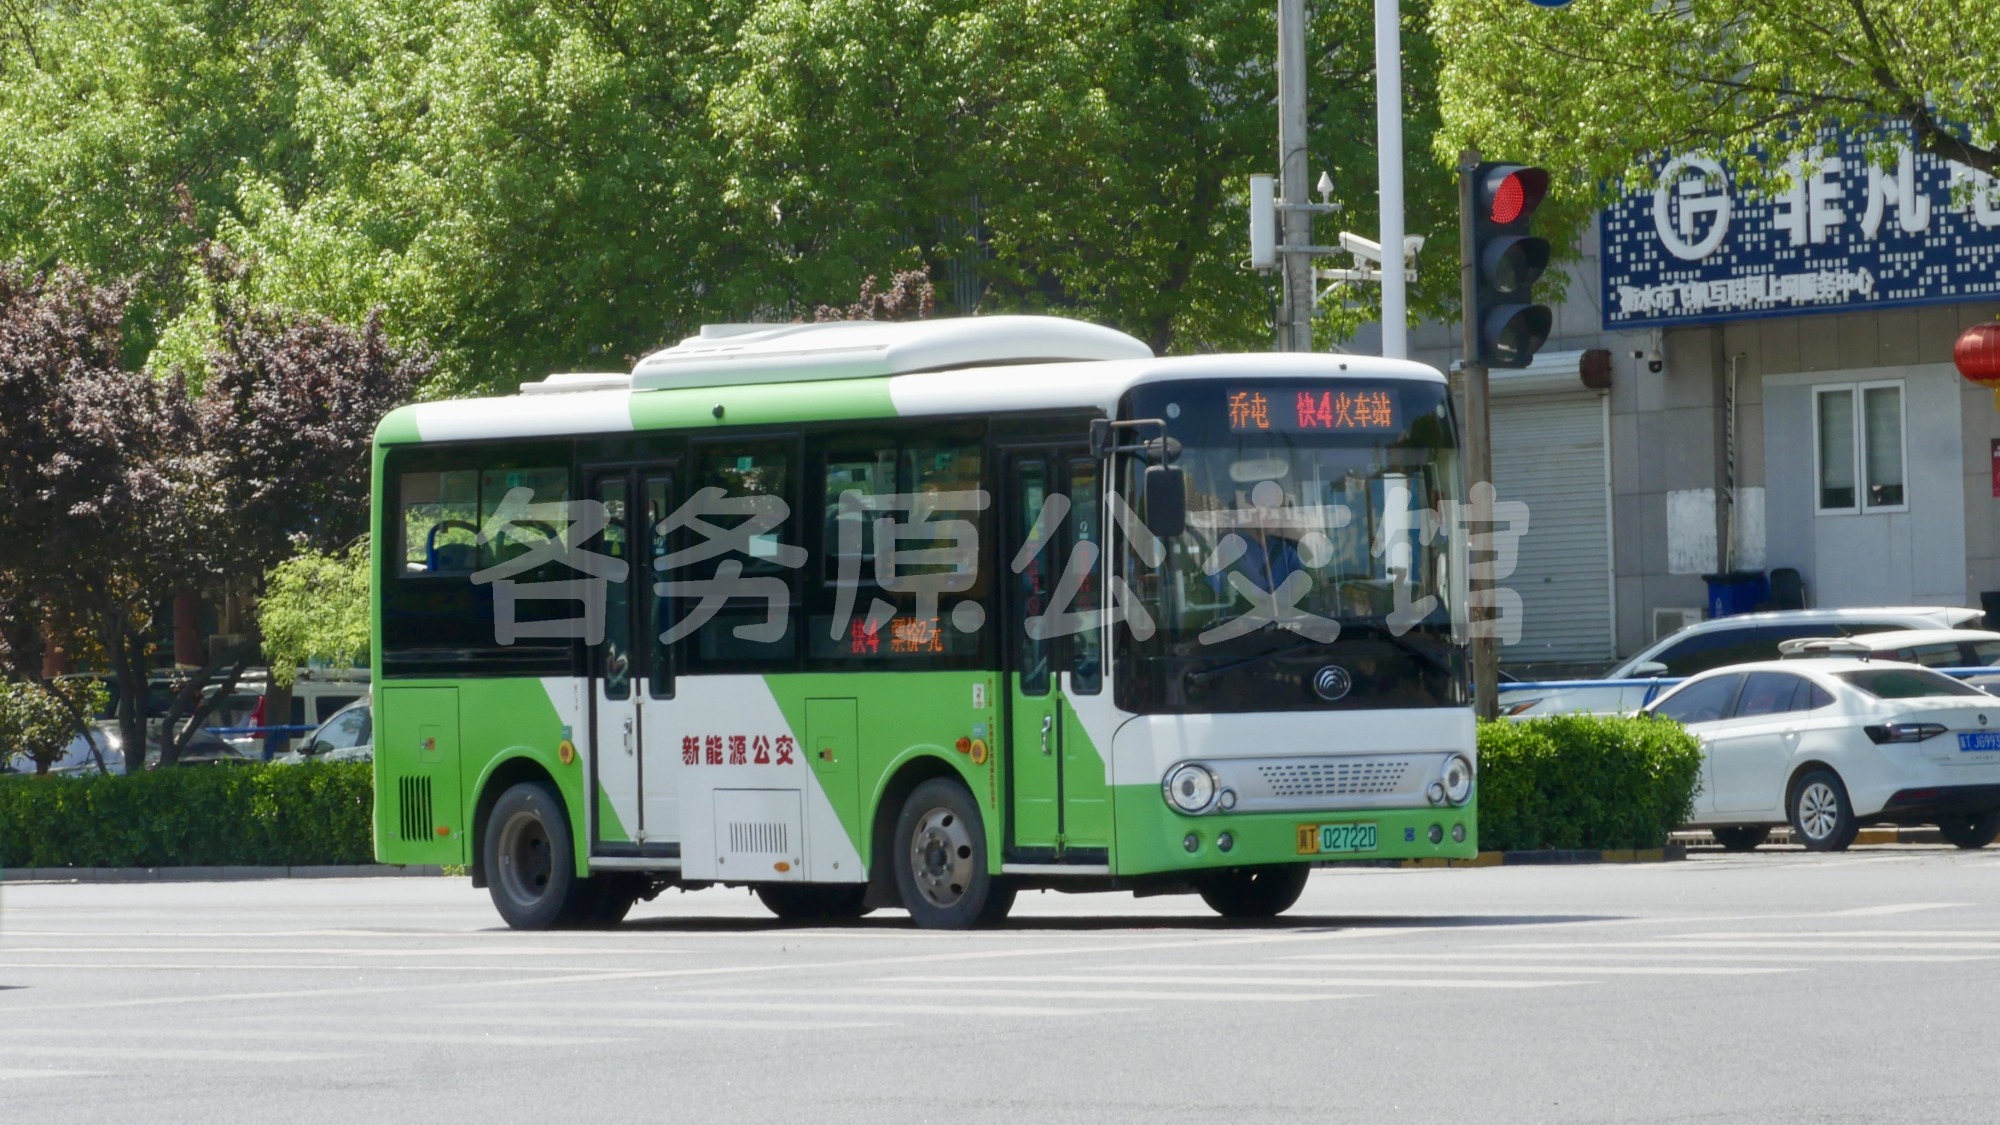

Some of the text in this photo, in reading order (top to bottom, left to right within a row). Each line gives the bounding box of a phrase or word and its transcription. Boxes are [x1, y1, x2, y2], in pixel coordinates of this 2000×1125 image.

[1229, 391, 1270, 429] 乔屯
[681, 734, 795, 766] 新能源公交
